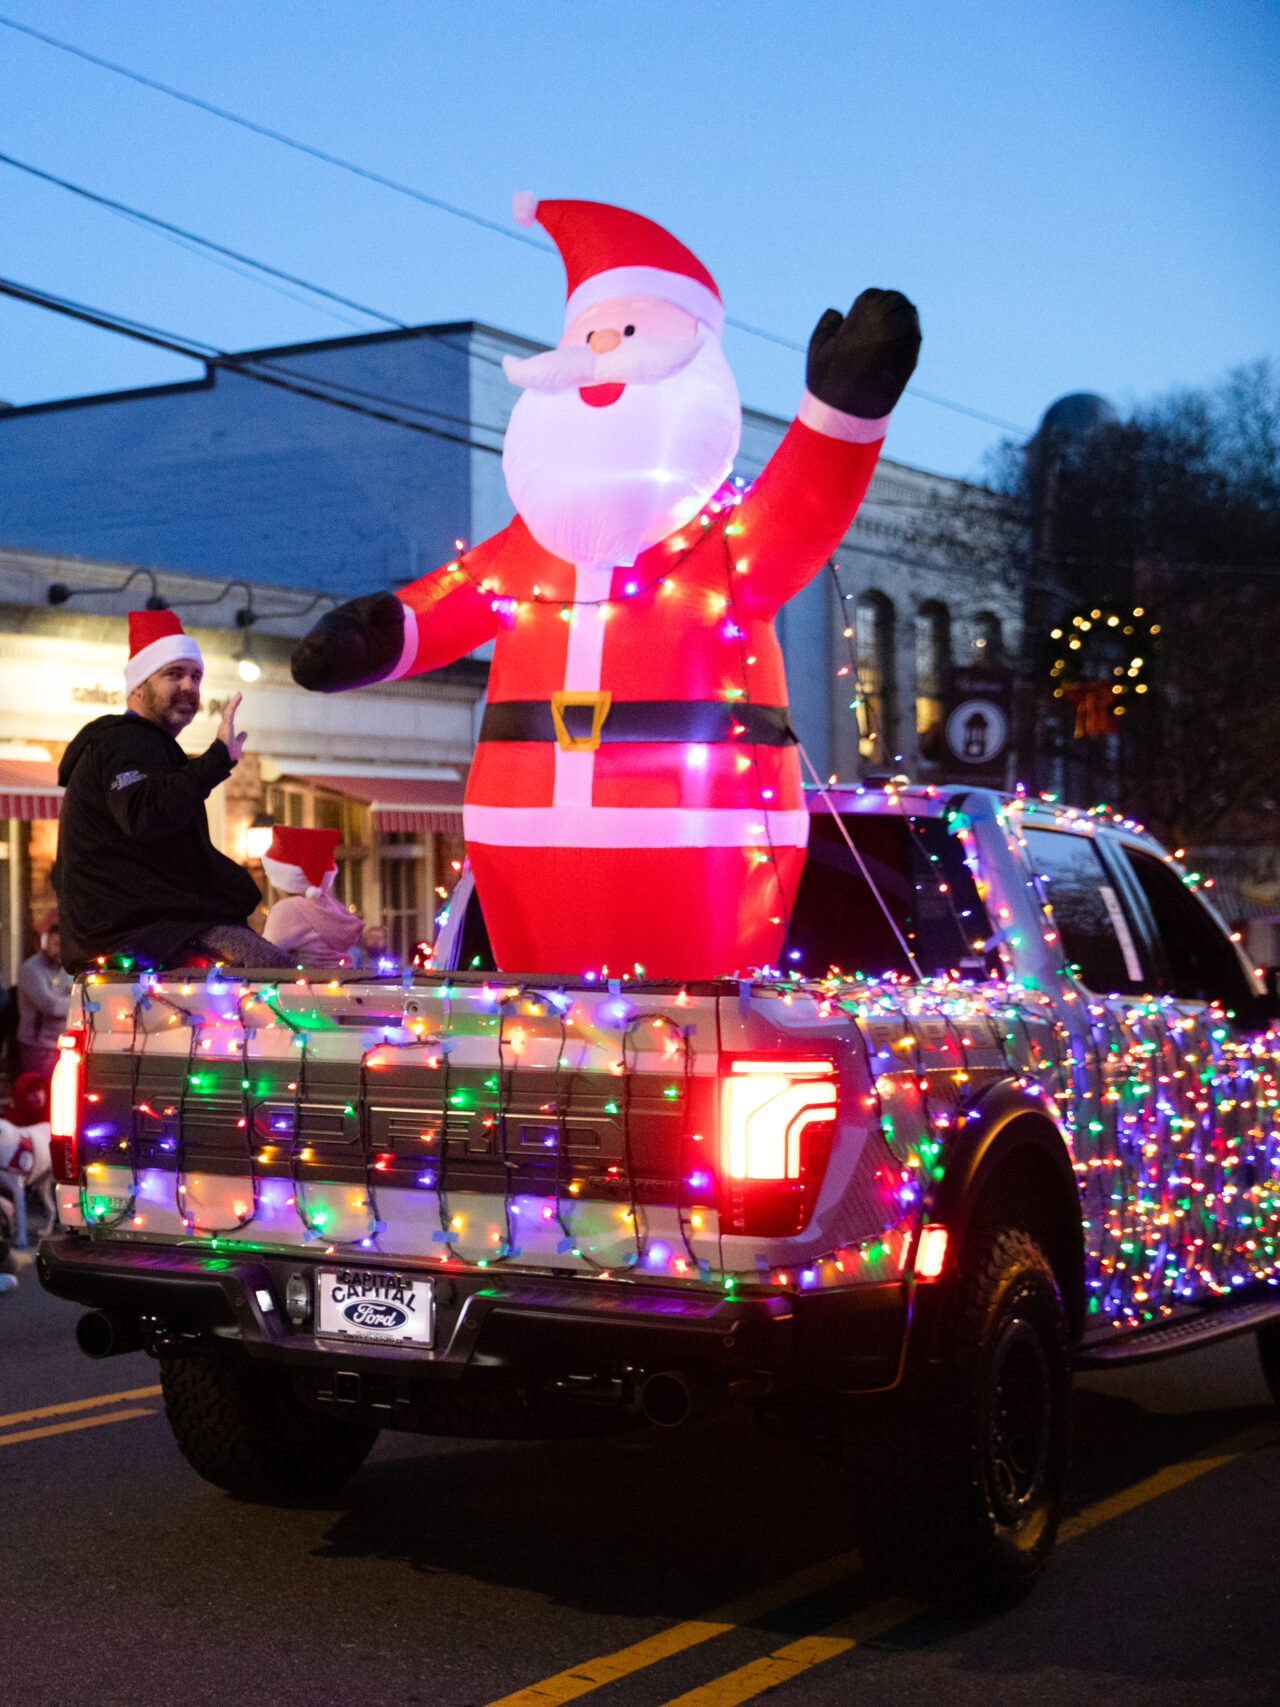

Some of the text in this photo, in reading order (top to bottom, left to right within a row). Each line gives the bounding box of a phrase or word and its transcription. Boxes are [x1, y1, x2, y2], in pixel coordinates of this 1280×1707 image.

[342, 1271, 408, 1290] CAPITAL
[331, 1285, 416, 1312] CAPITAL
[352, 1303, 397, 1328] Ford
